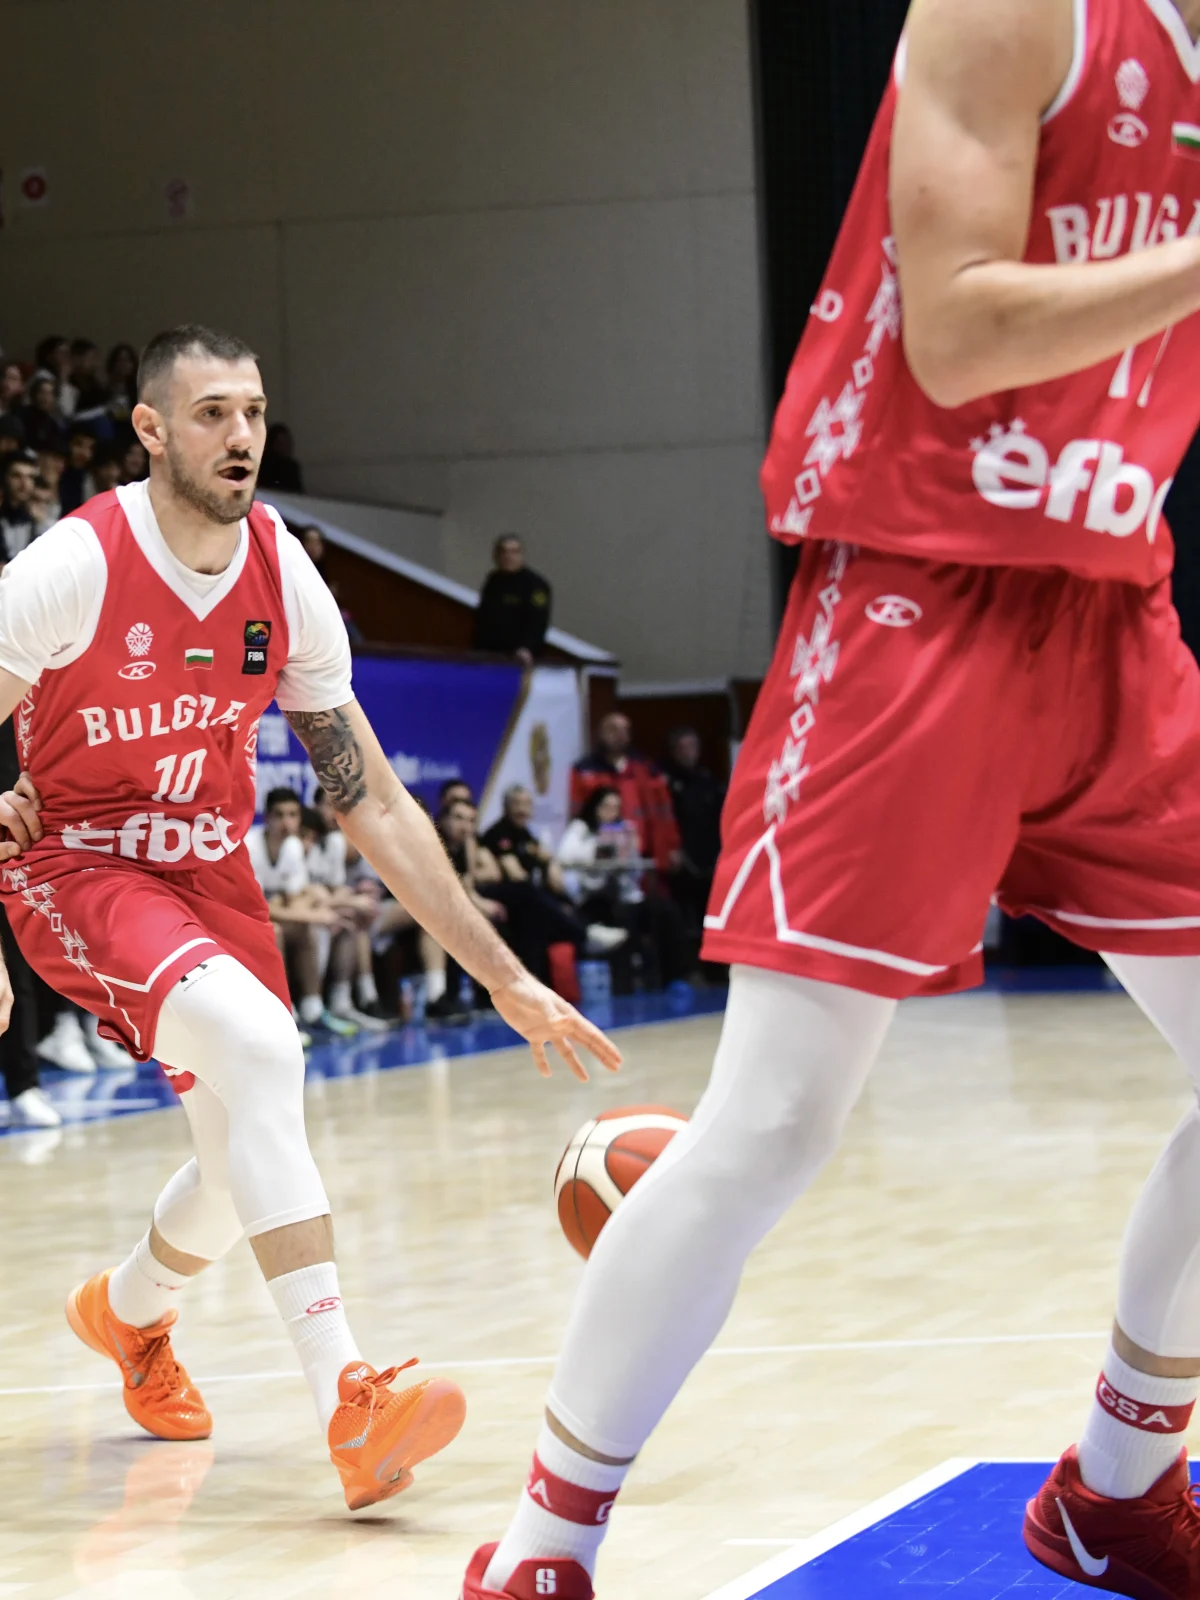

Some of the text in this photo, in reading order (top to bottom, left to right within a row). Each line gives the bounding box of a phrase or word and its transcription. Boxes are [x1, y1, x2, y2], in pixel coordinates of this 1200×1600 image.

[151, 748, 208, 804] 10
[1099, 1382, 1173, 1429] GSA
[535, 1568, 557, 1595] S
